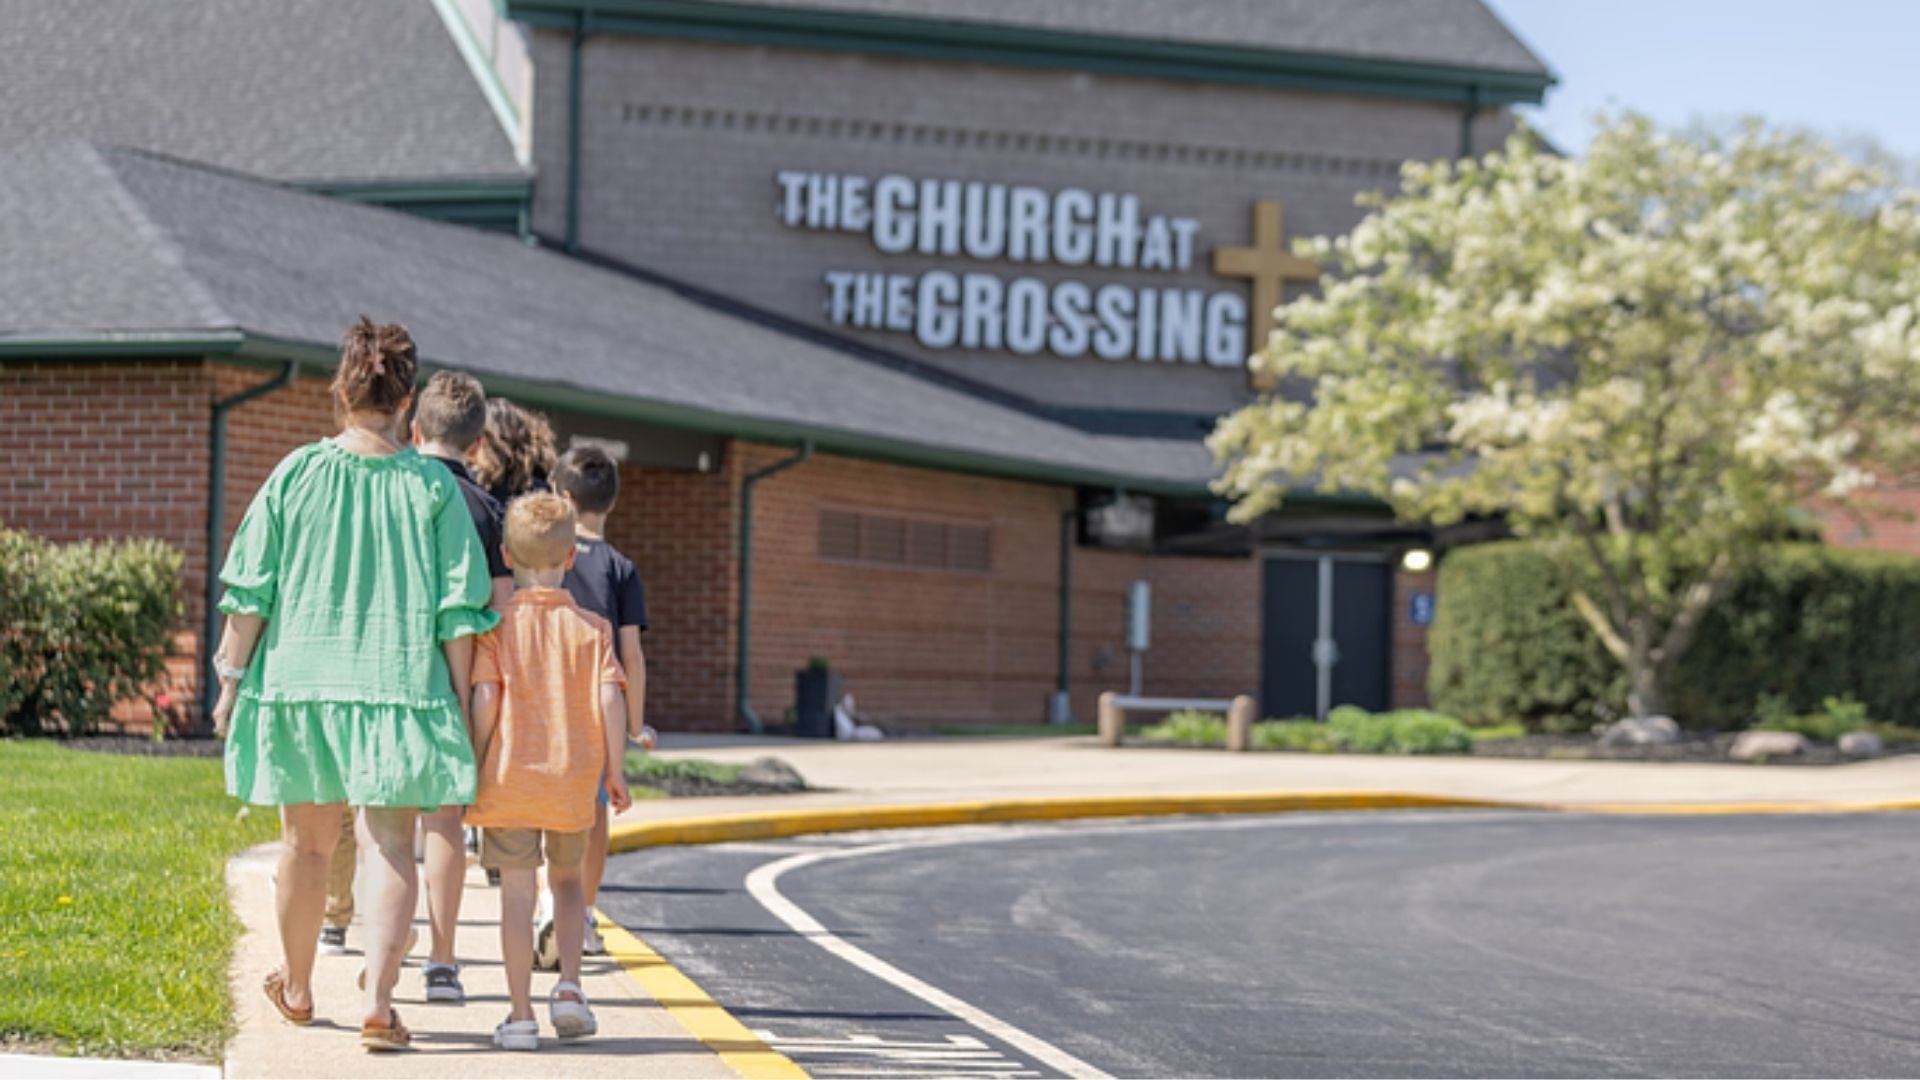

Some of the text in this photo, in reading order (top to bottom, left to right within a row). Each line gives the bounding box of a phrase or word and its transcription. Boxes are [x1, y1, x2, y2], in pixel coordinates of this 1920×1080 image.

[777, 172, 1199, 271] THE CHURCH AT
[825, 270, 1246, 367] THE CROSSING
